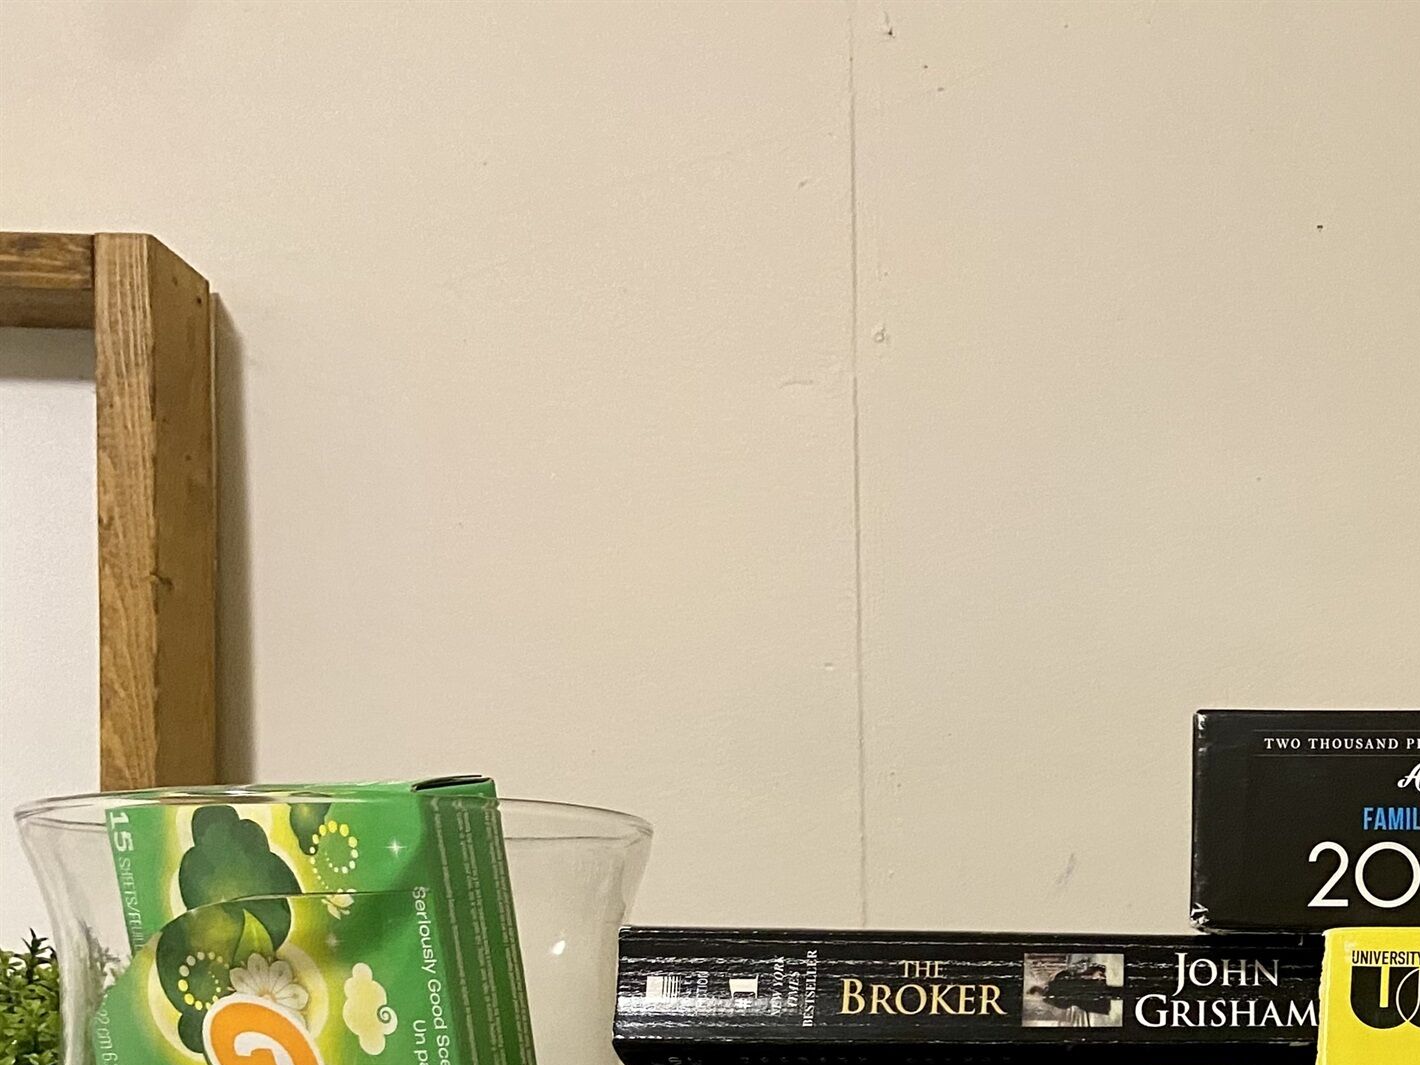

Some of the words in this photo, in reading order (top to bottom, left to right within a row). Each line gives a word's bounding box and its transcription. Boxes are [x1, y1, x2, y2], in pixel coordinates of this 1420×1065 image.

[1263, 737, 1301, 750] TWO
[1308, 737, 1400, 750] THOUSAND
[109, 811, 134, 852] 15
[412, 886, 437, 975] Seriously
[428, 979, 447, 1030] Good
[899, 960, 948, 979] THE
[1172, 952, 1279, 997] JOHN
[802, 949, 818, 1028] BESTSELLER
[839, 977, 1008, 1016] BROKER
[1135, 994, 1319, 1028] GRISHAM
[412, 1020, 427, 1045] Un
